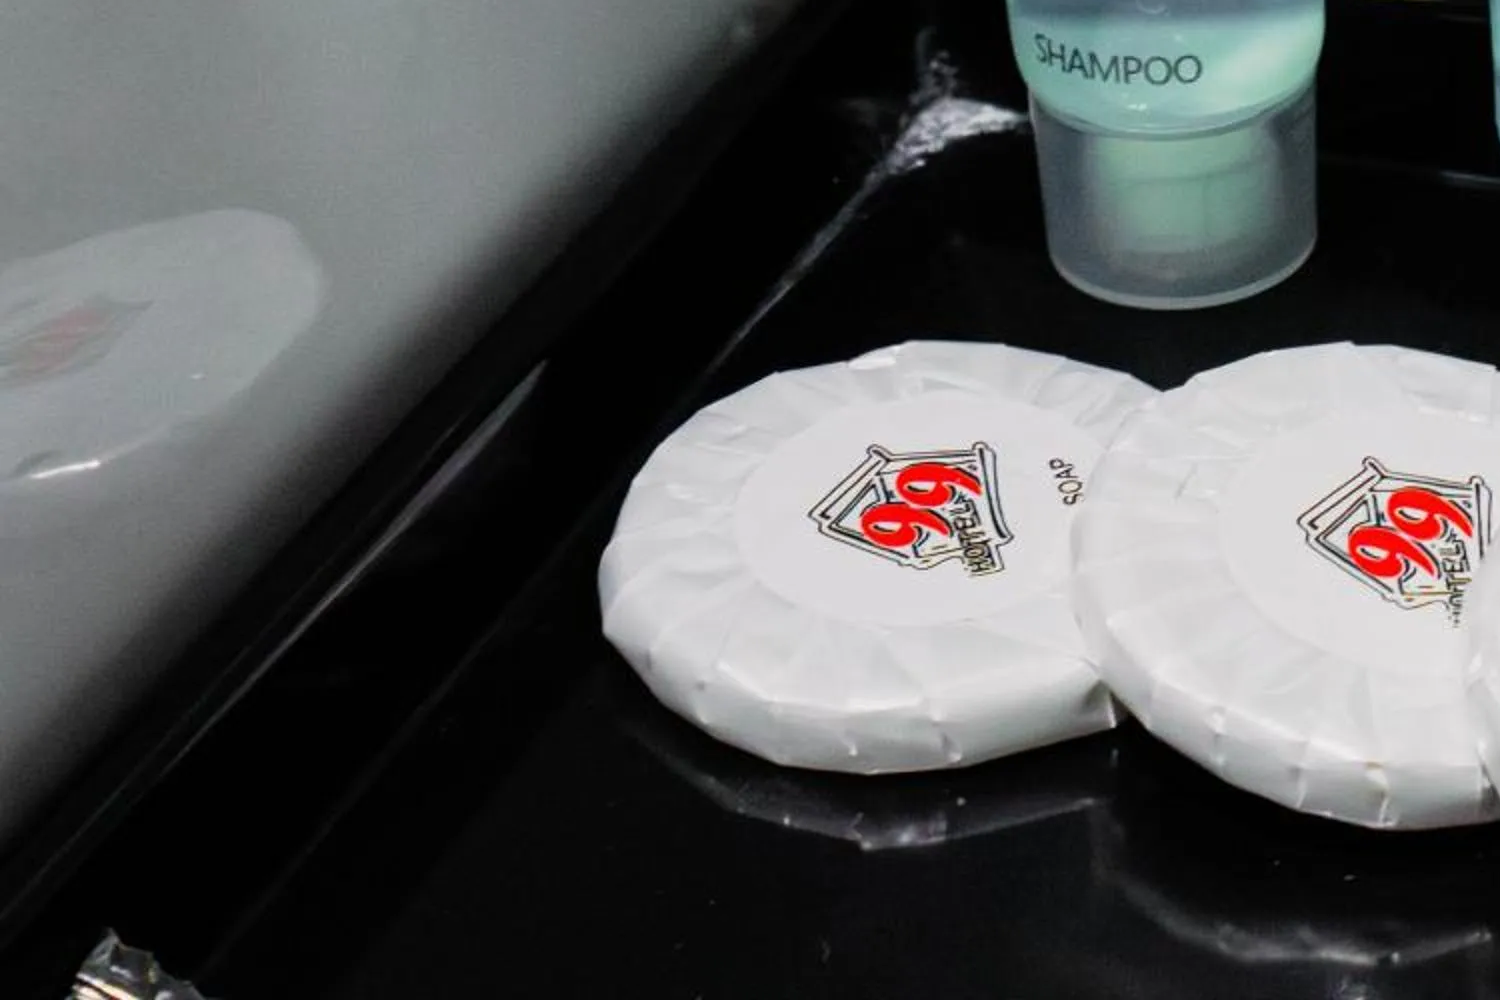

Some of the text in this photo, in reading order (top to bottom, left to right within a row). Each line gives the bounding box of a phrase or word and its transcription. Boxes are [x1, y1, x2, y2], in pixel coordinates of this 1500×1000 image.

[1034, 33, 1203, 85] SHAMPOO
[859, 461, 983, 547] 99
[1050, 458, 1084, 506] SOAP
[1347, 486, 1474, 579] 99
